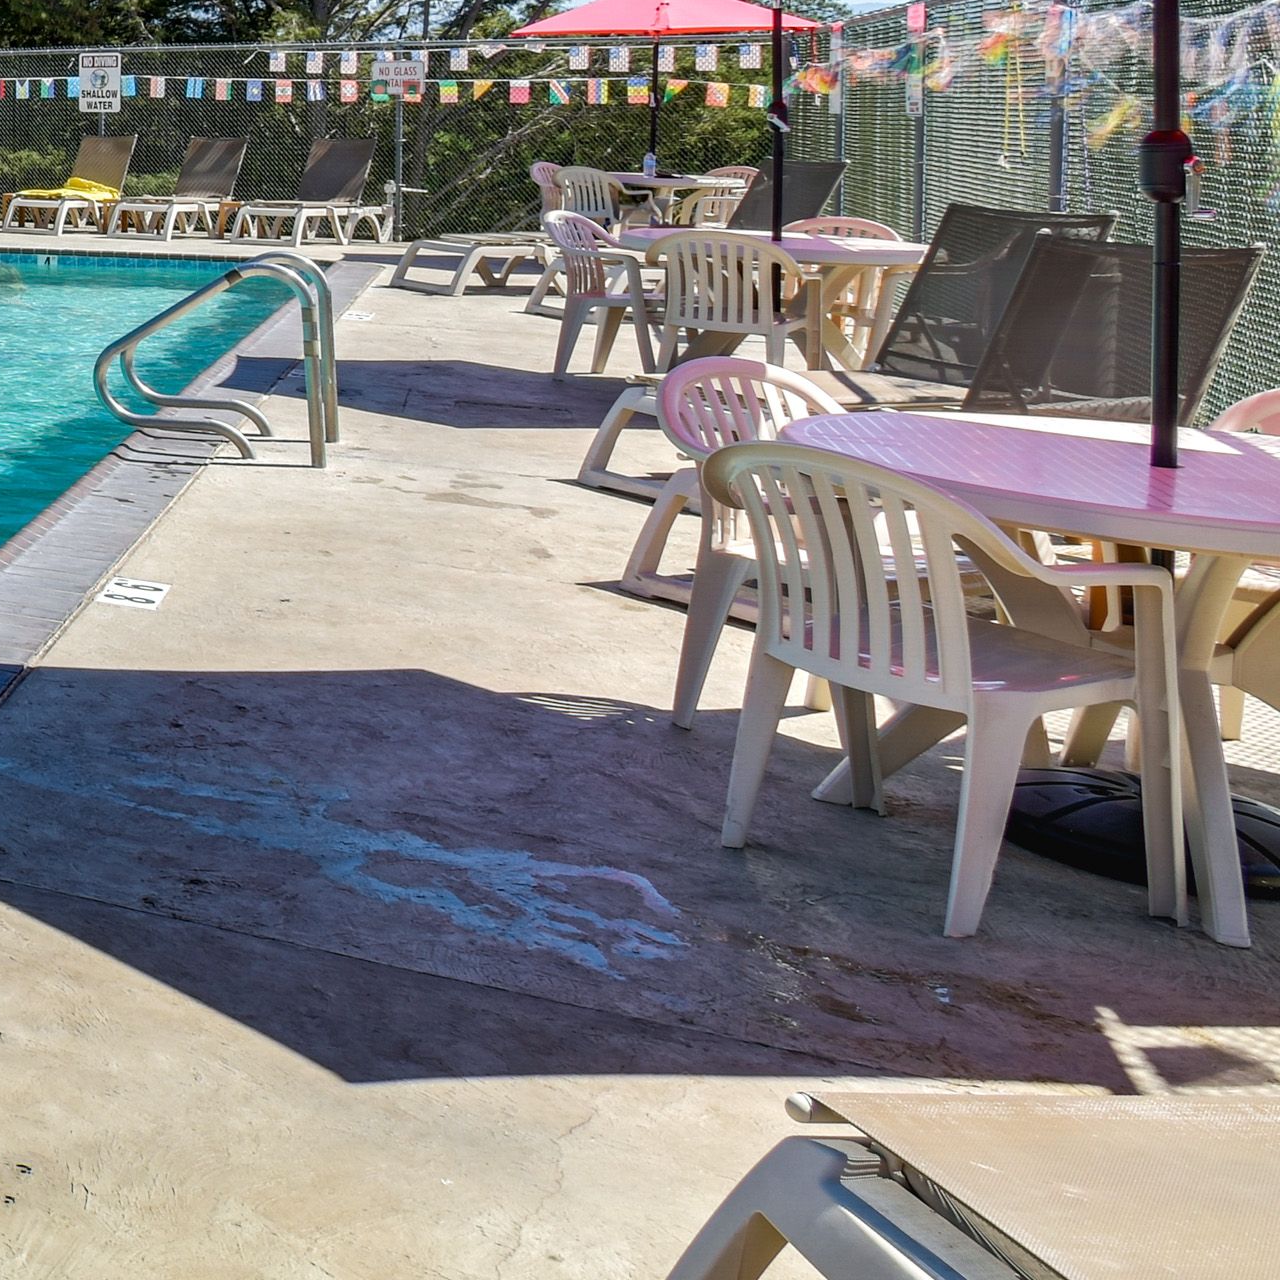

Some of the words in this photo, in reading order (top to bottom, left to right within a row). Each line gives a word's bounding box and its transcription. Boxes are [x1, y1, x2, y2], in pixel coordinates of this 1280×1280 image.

[82, 56, 93, 67] NO
[93, 56, 117, 67] DIVING
[378, 66, 390, 76] NO
[393, 66, 417, 76] GLASS
[81, 90, 118, 99] SHALLOW
[86, 101, 113, 110] WATER
